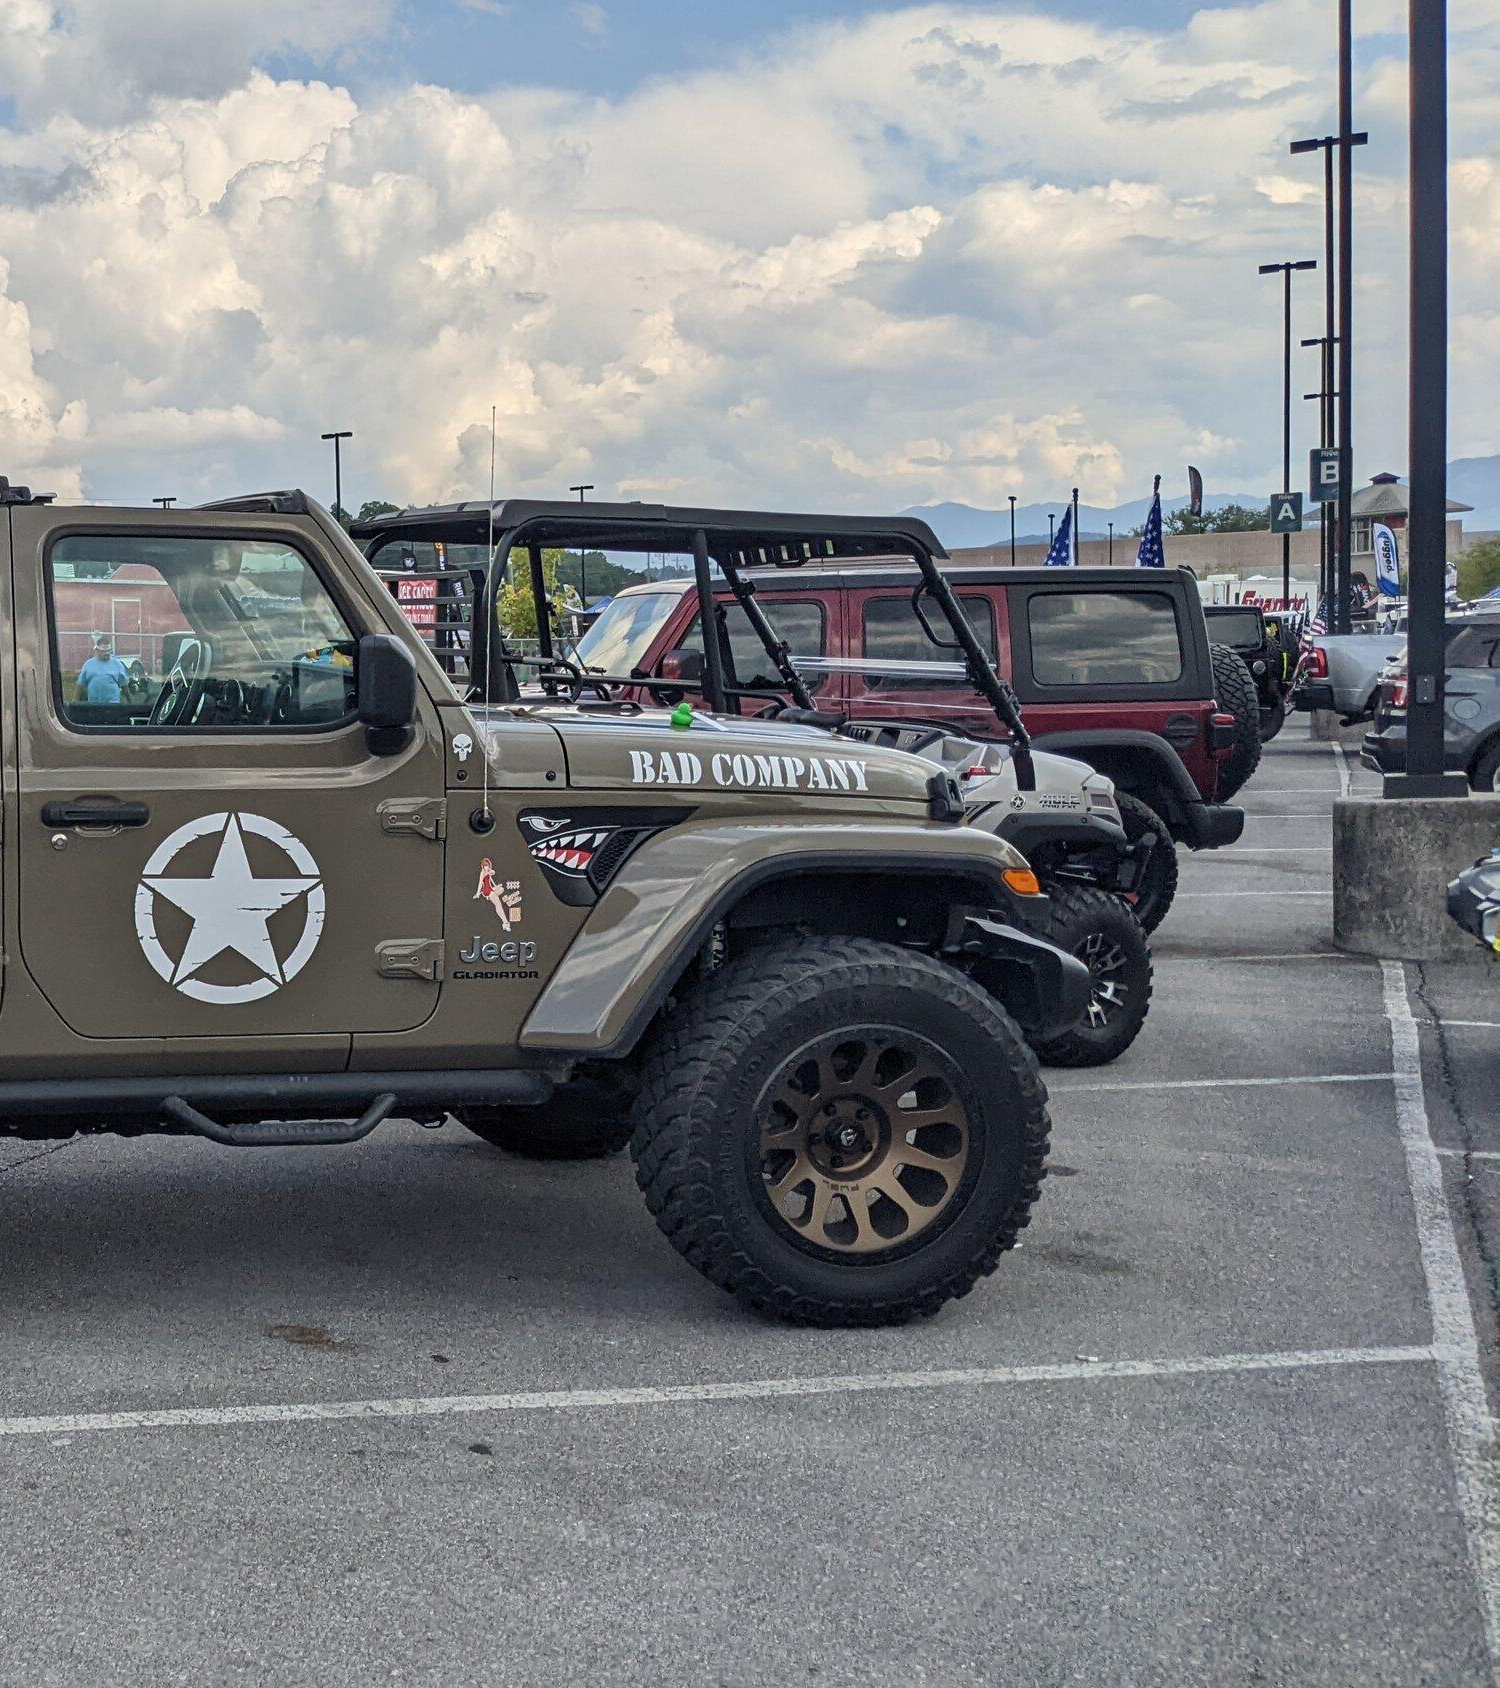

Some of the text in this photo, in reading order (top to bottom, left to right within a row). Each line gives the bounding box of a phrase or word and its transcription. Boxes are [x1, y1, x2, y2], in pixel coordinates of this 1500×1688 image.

[1321, 461, 1339, 484] B
[1277, 503, 1296, 520] A
[629, 750, 869, 791] BAD COMPANY
[1038, 794, 1081, 805] MULE
[460, 936, 537, 967] Jeep
[452, 971, 539, 980] GLADIATOR
